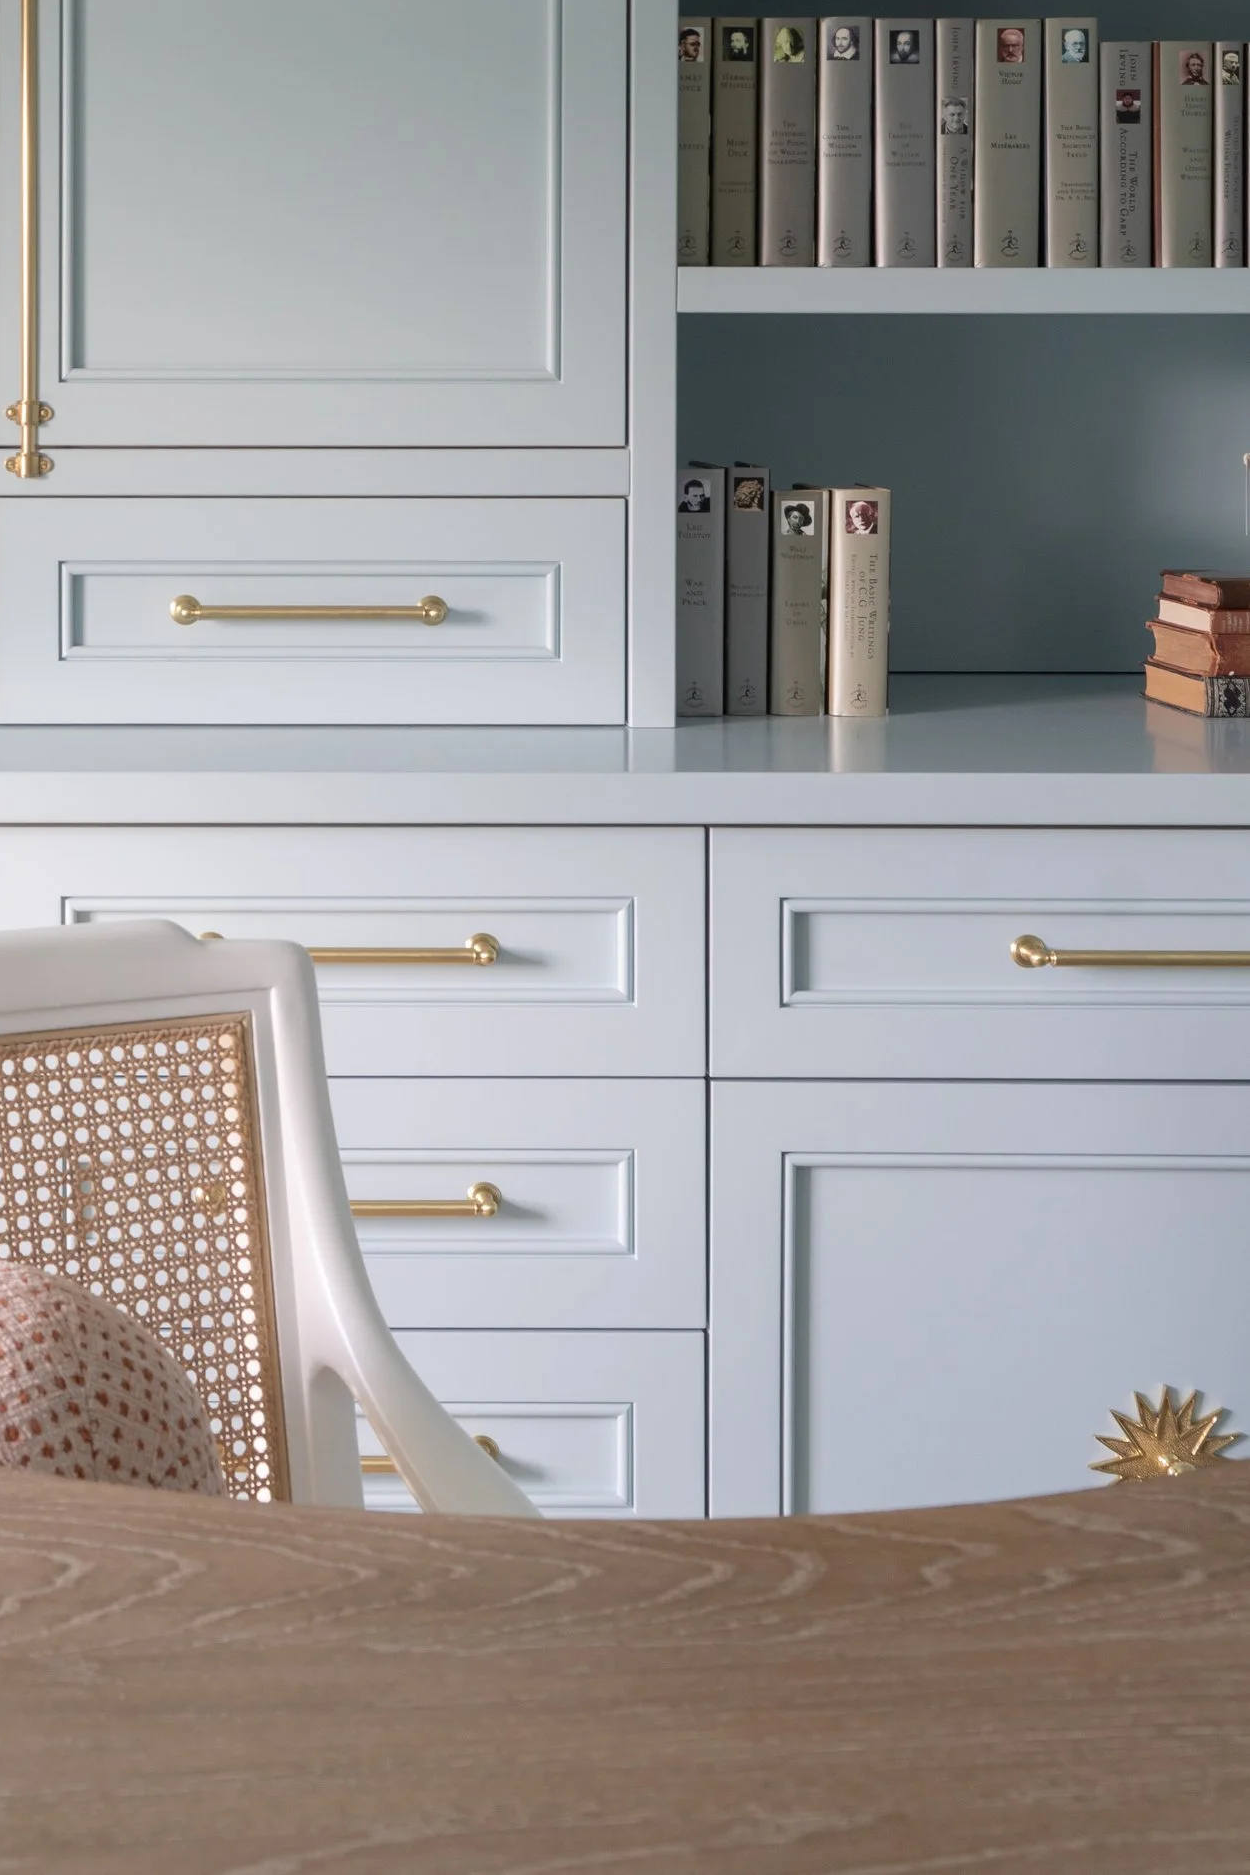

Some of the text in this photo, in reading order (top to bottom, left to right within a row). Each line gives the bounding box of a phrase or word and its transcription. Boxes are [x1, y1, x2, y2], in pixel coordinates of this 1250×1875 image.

[951, 26, 961, 51] JOHN
[1118, 49, 1128, 87] IRVING
[1128, 53, 1139, 81] JOHN
[950, 156, 959, 181] ONE
[960, 159, 968, 197] WIDOW
[1119, 128, 1129, 236] ACCORDING TO GARP
[1129, 150, 1138, 213] THE WORLD
[685, 578, 704, 587] WAR
[859, 571, 866, 583] OF
[867, 553, 878, 660] THE BASIC WRITINGS
[856, 615, 867, 642] JUNG
